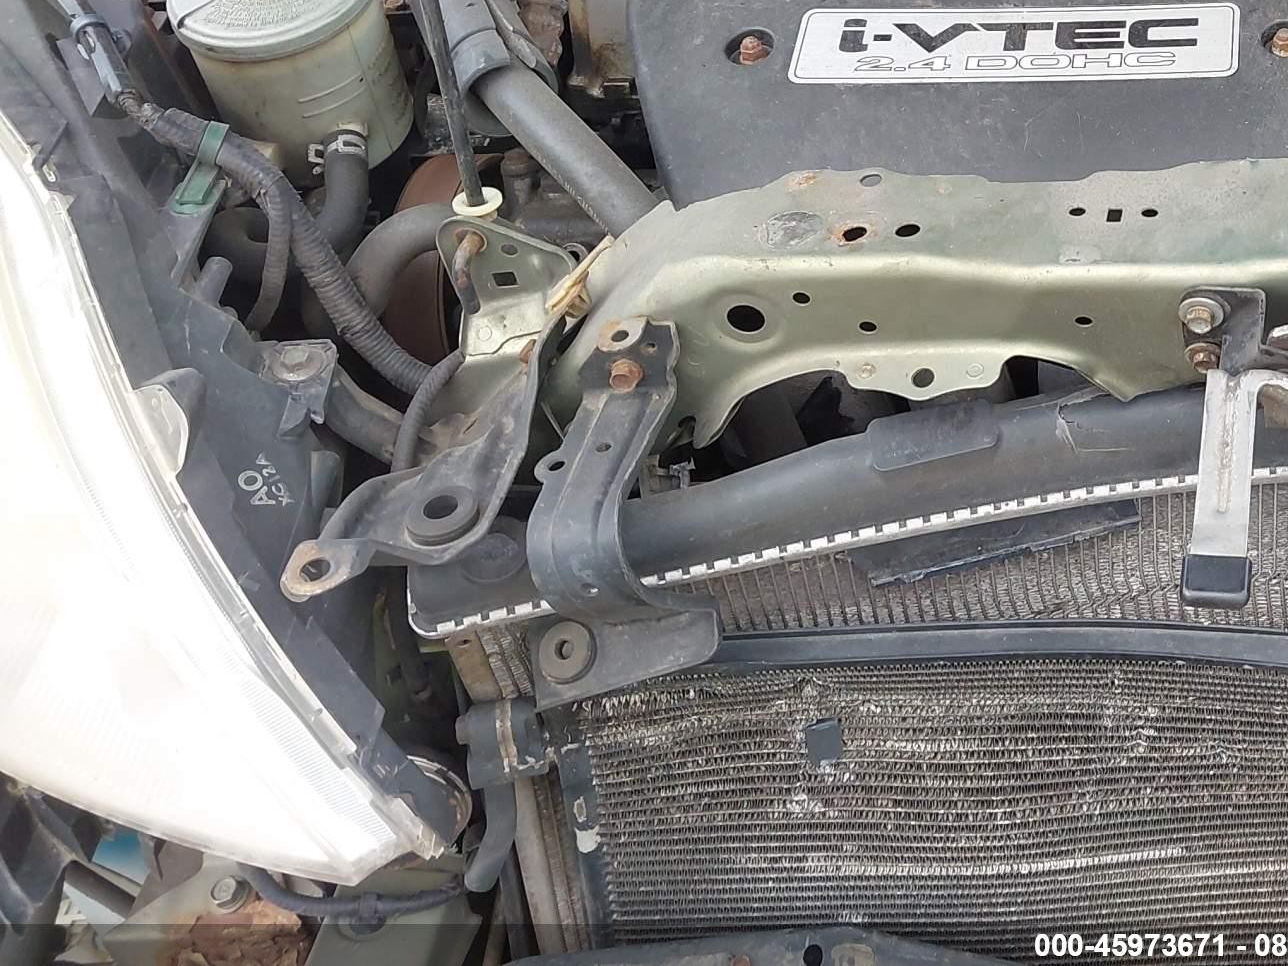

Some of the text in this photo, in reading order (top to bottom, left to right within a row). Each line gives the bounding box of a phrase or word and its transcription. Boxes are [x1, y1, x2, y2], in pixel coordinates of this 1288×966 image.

[839, 18, 1199, 54] i-VTEC
[853, 51, 1176, 73] 2.4 DOHC
